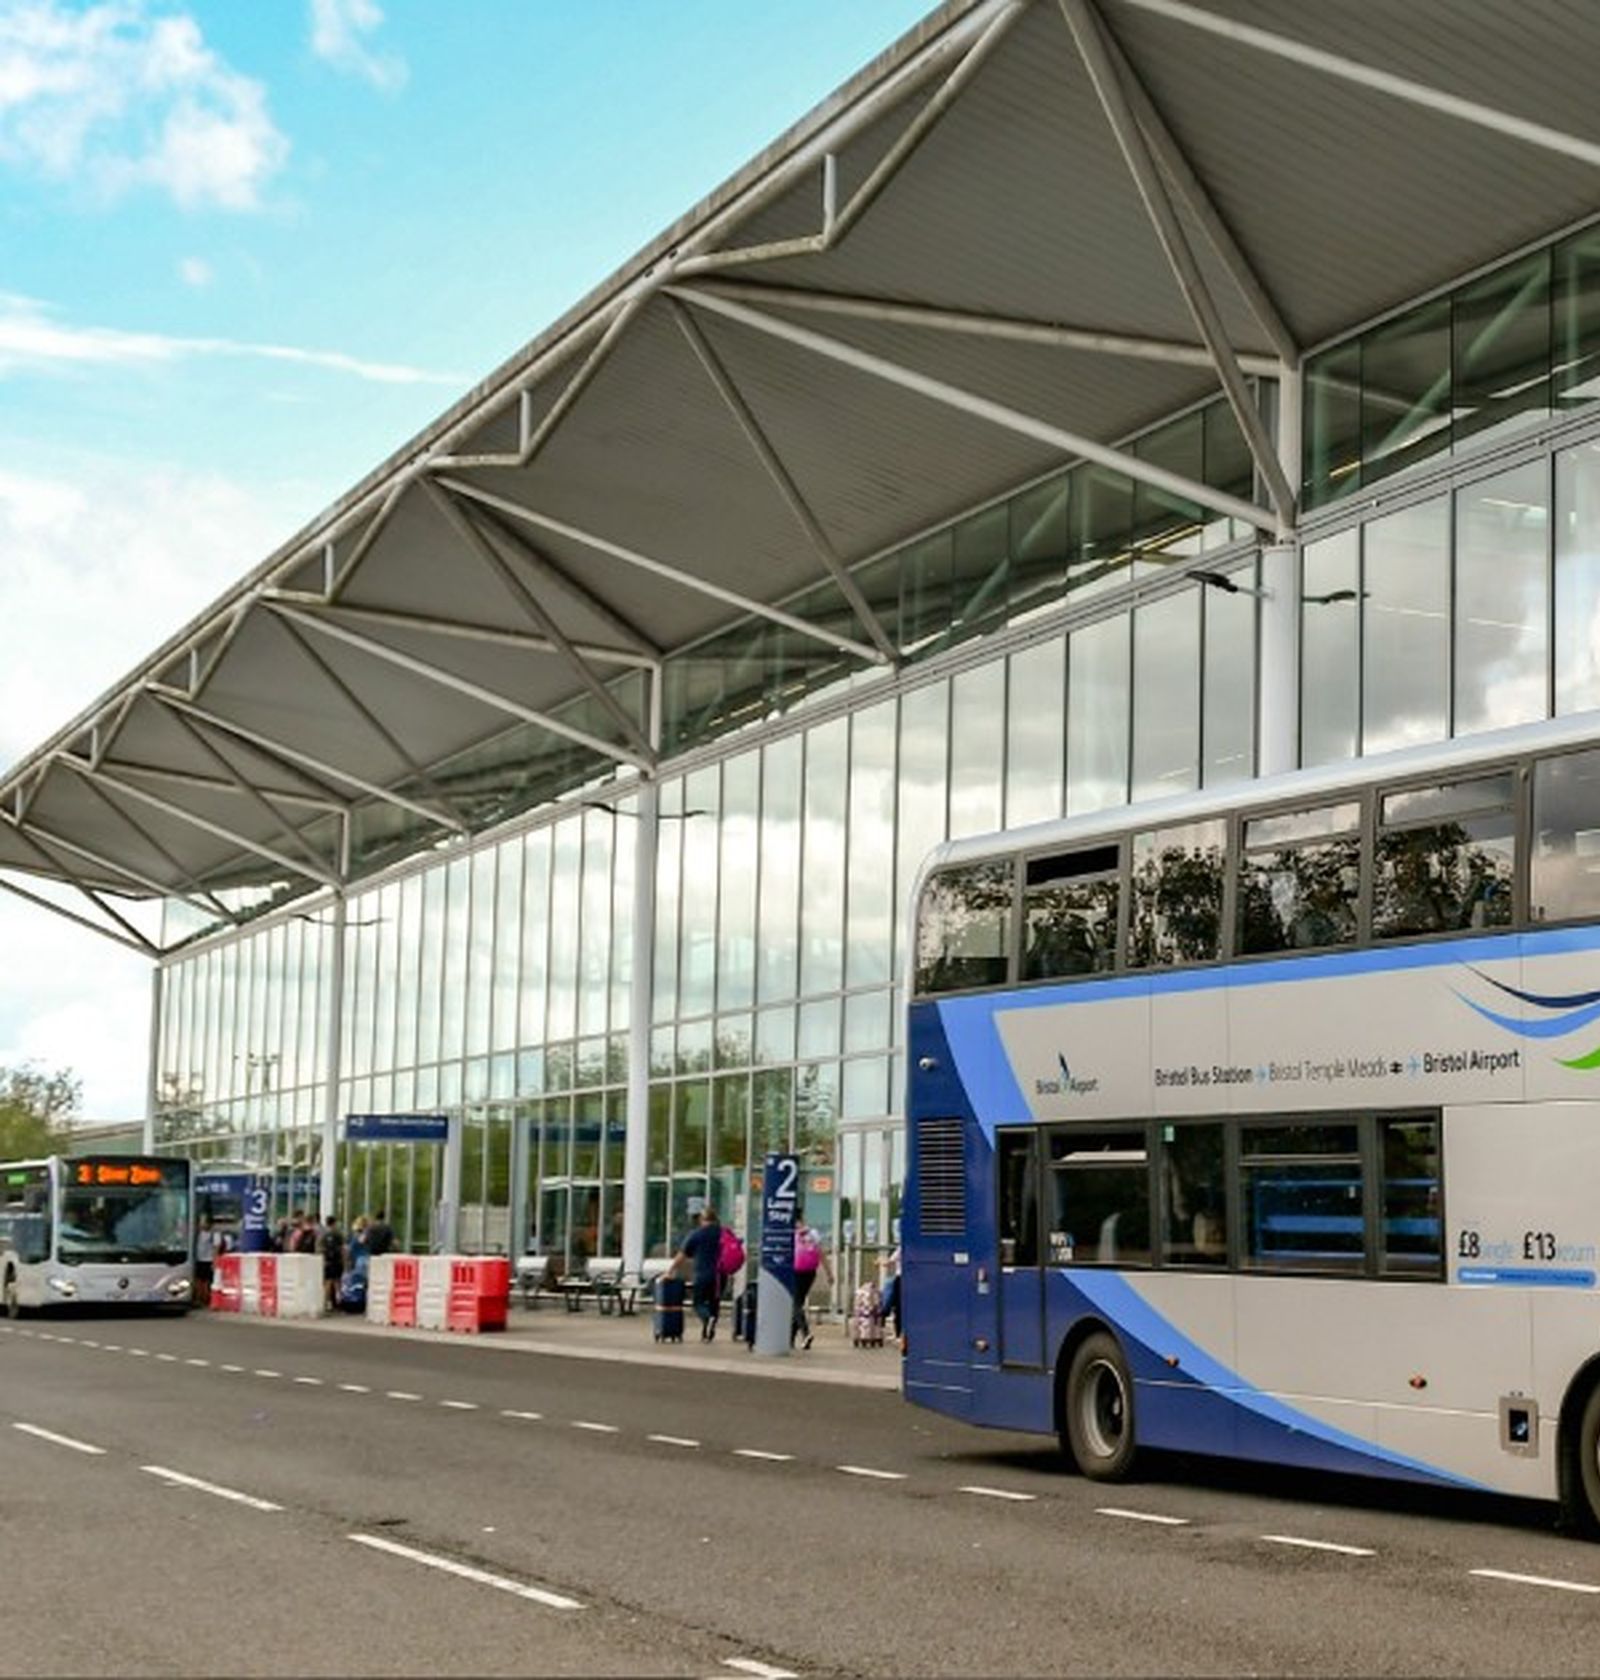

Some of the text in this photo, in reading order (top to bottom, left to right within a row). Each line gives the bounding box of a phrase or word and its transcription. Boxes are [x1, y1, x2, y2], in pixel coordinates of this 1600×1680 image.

[1155, 1049, 1520, 1087] Bristol Bus Station Bristol Temple Meads Bristol Airport
[1069, 1078, 1100, 1096] Airport
[776, 1159, 798, 1198] 2
[251, 1188, 268, 1215] 3
[1458, 1229, 1481, 1259] £8
[1523, 1231, 1557, 1260] £13
